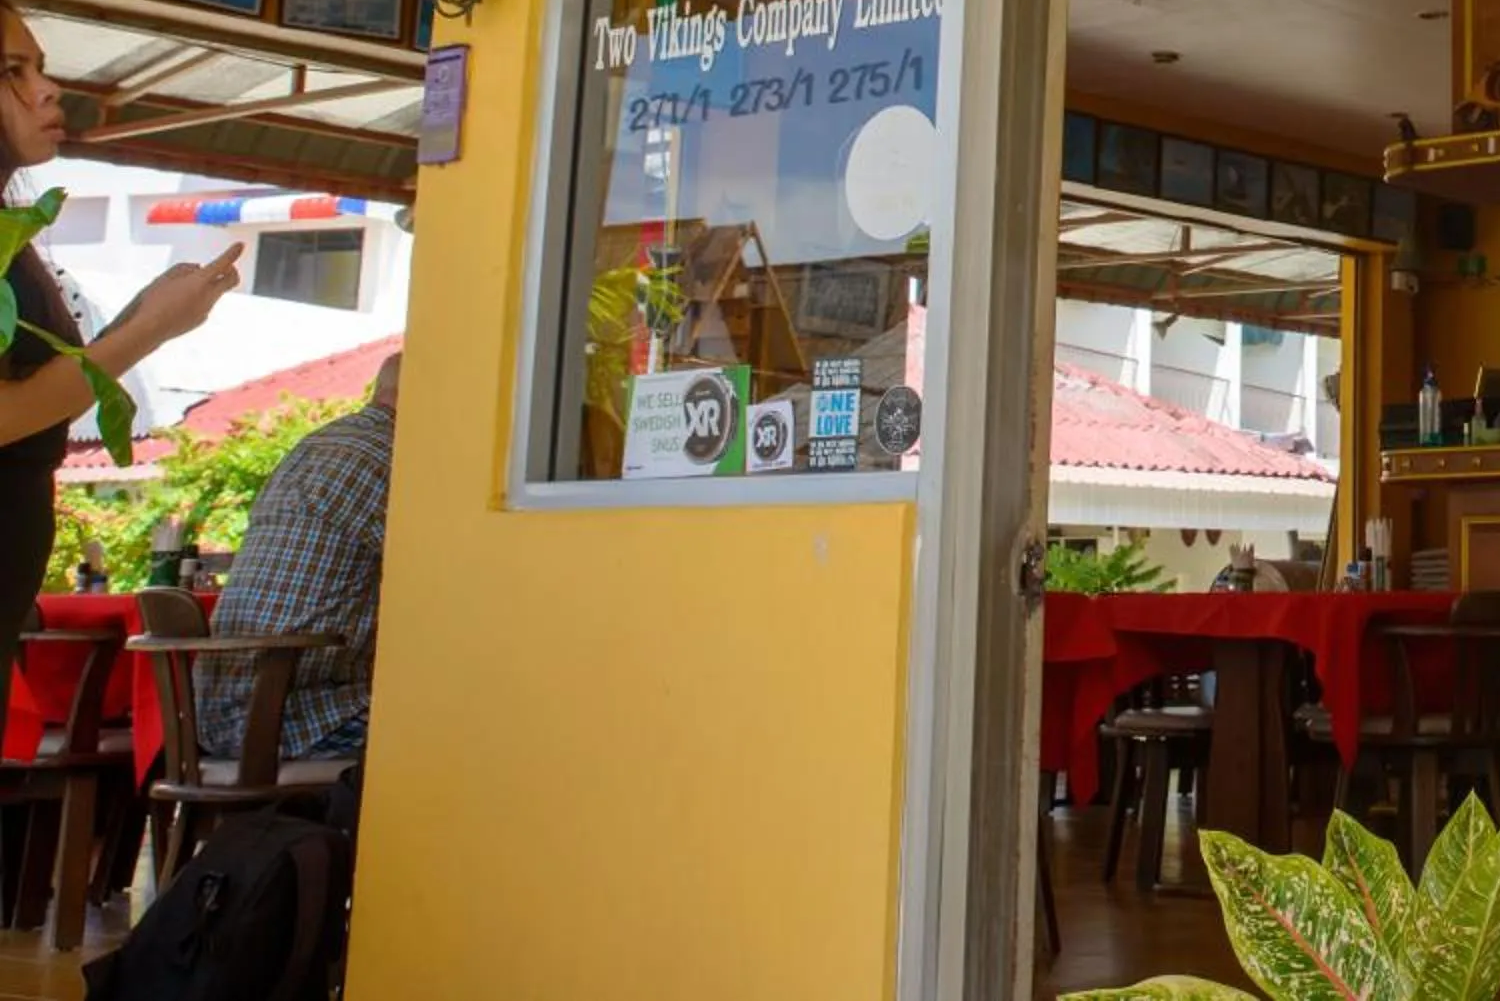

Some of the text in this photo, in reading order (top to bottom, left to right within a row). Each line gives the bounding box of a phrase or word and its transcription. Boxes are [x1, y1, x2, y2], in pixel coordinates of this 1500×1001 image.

[594, 16, 638, 71] Two
[646, 3, 728, 71] Vikings
[628, 46, 925, 133] 271/1 273/1 275/1
[685, 399, 720, 437] XR
[815, 392, 857, 412] ONE
[815, 414, 852, 436] LOVE
